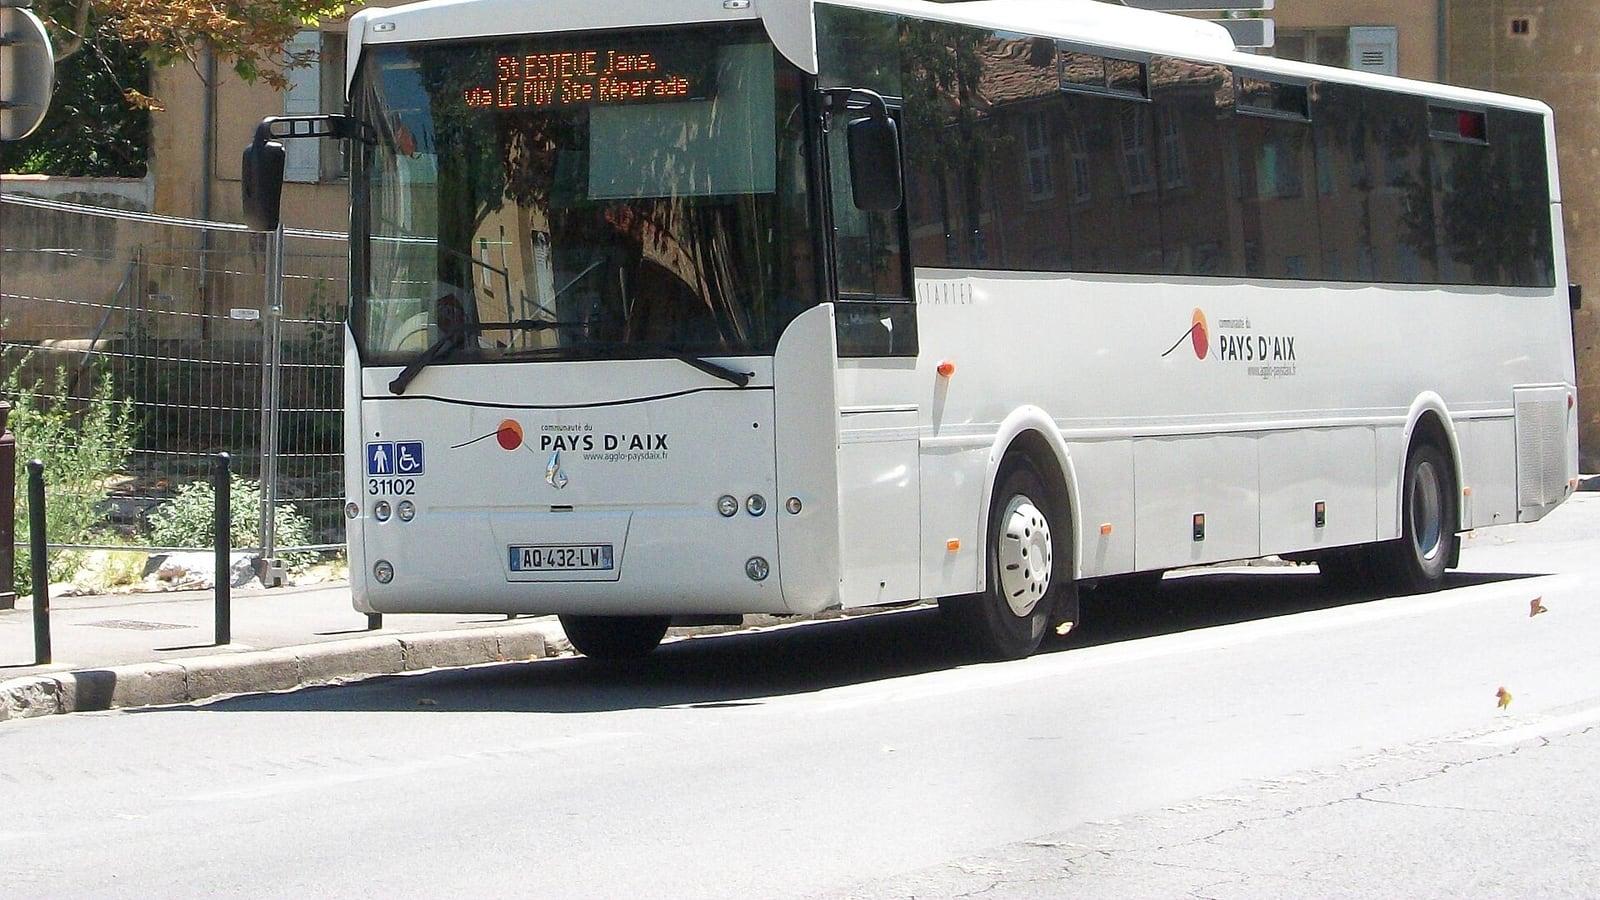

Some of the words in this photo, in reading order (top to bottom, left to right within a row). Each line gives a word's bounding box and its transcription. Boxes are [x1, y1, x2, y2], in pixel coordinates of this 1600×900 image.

[498, 56, 519, 81] St
[525, 51, 597, 80] ESTEVE
[464, 86, 492, 107] via
[498, 82, 517, 108] LE
[523, 80, 556, 106] PUY
[561, 79, 593, 104] Ste
[917, 282, 973, 305] STARTER
[1220, 335, 1254, 361] PAYS
[1258, 336, 1296, 361] D'AIX
[584, 422, 593, 432] du
[540, 434, 594, 451] PAYS
[604, 434, 668, 450] D'AIX
[583, 452, 668, 463] www.agglo-paysdaix.fr
[368, 478, 416, 496] 31102
[523, 548, 600, 568] AQ-432-LW
